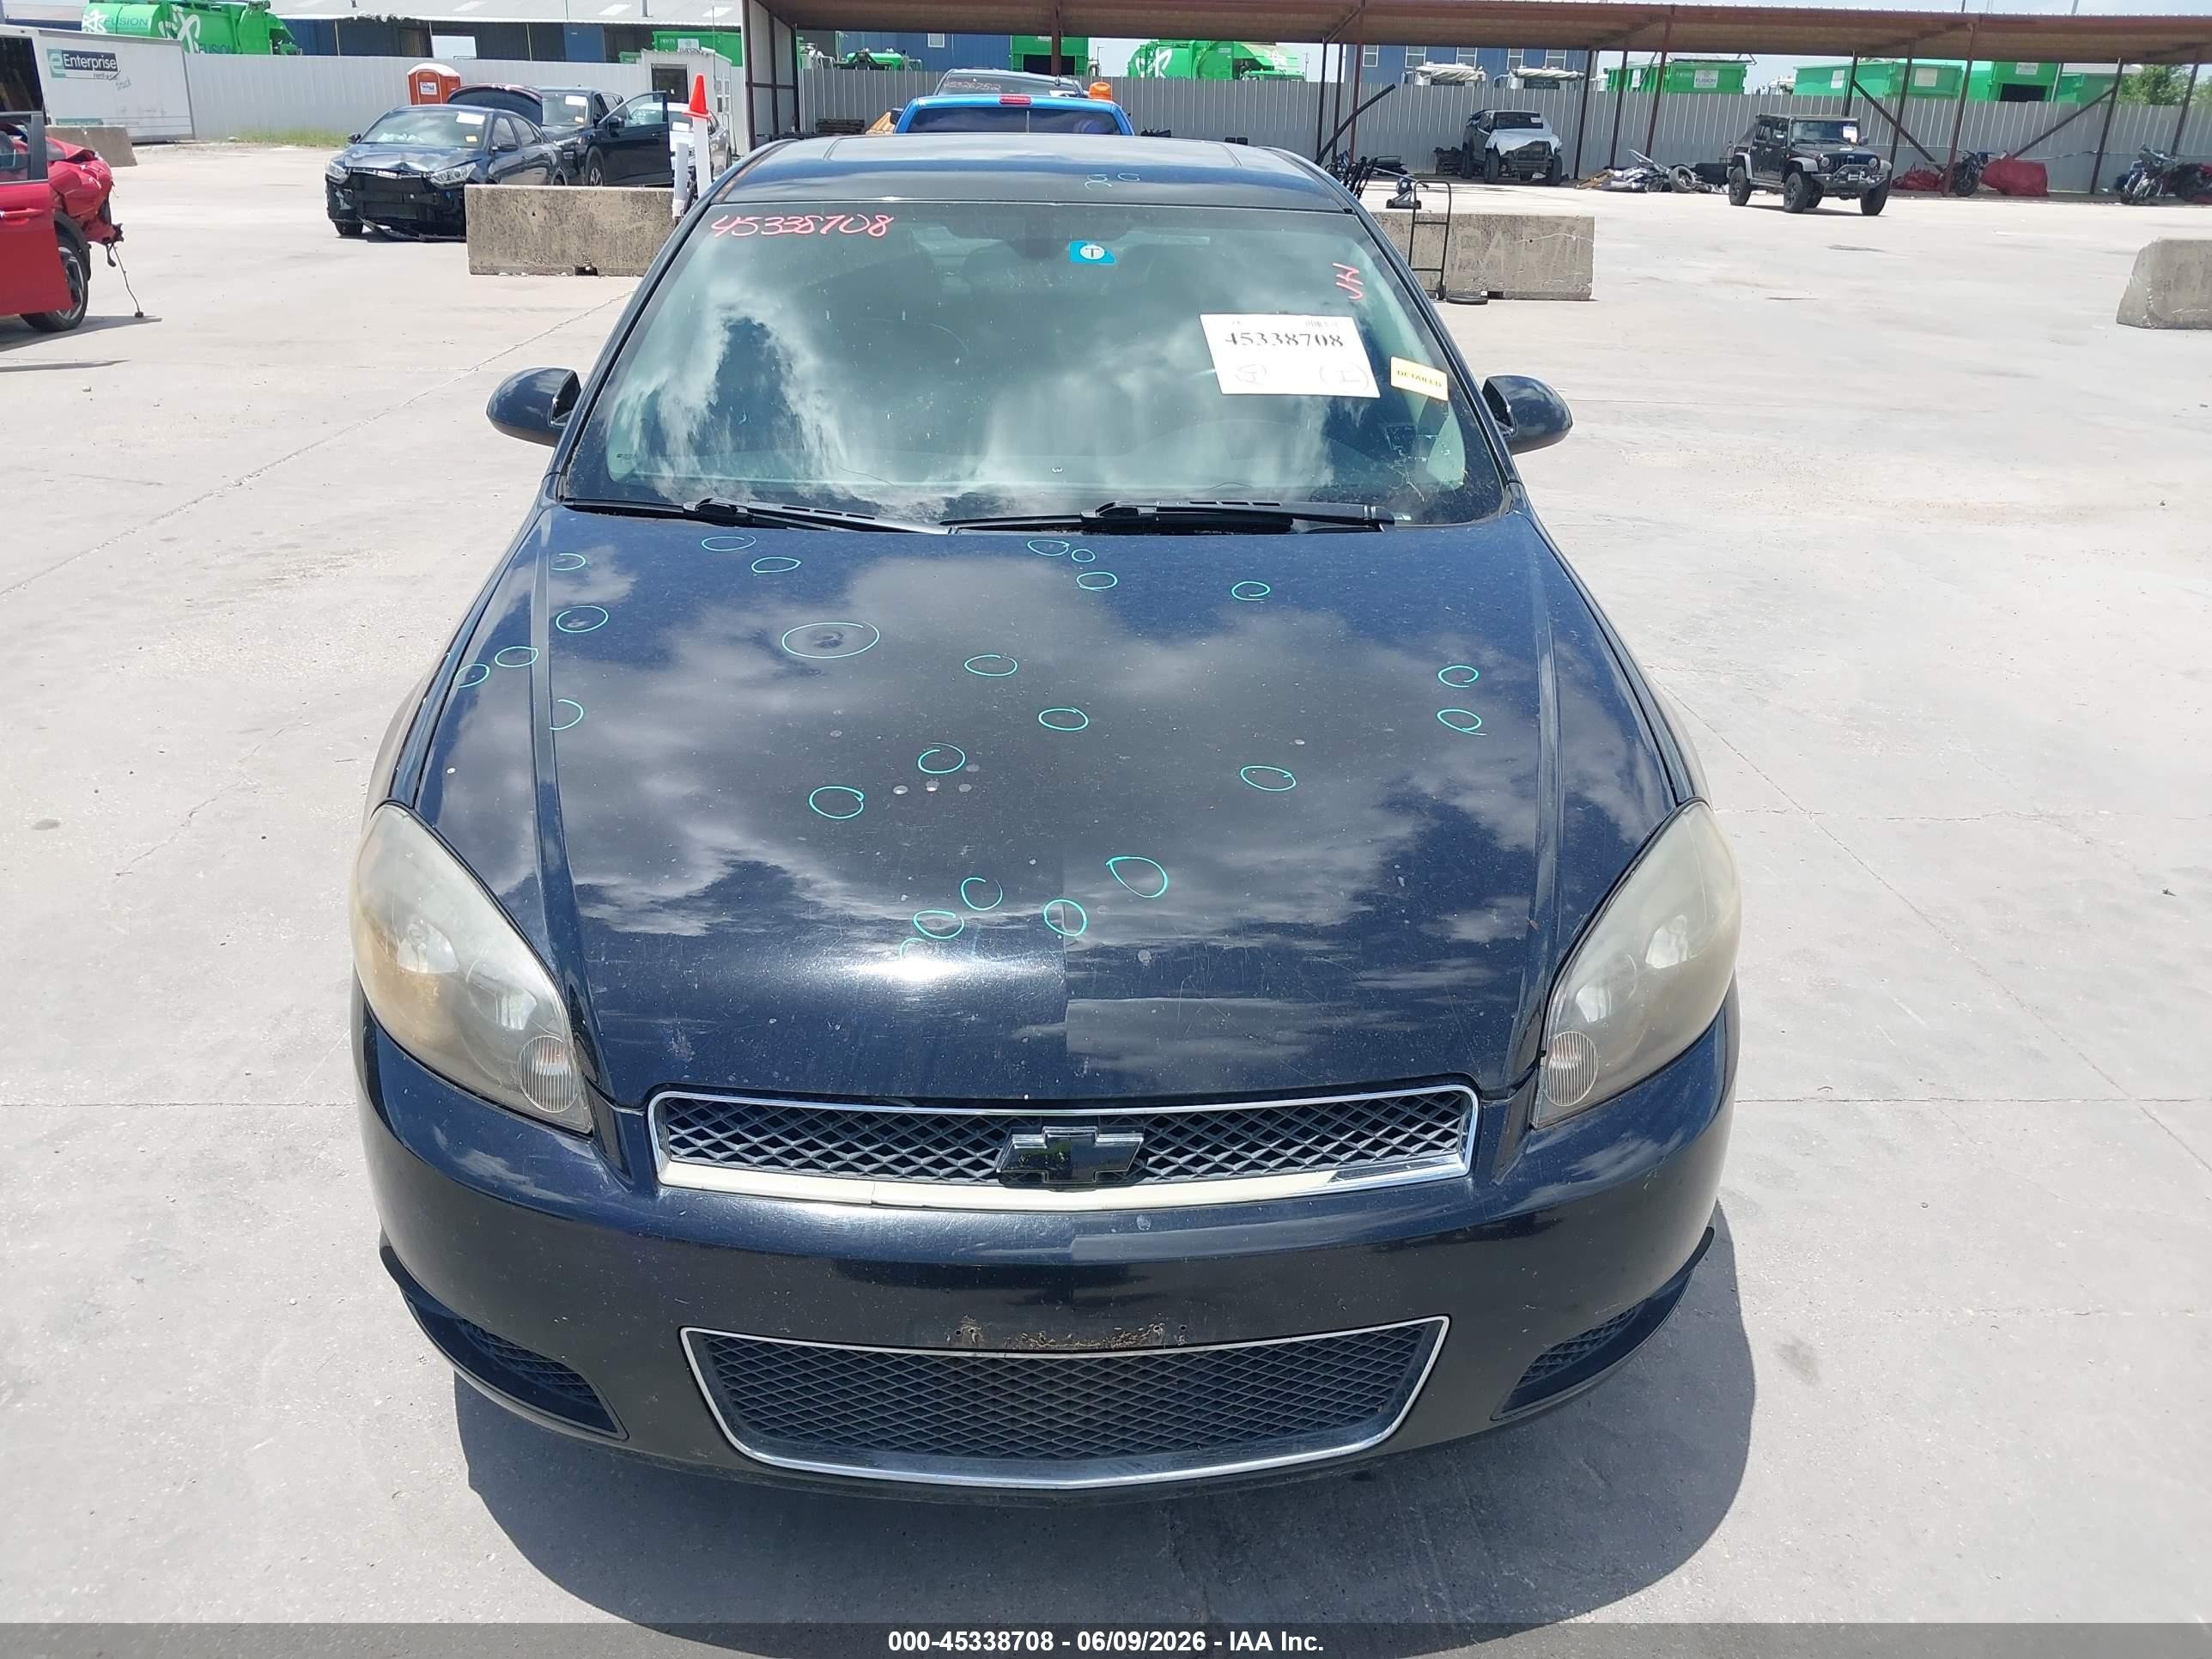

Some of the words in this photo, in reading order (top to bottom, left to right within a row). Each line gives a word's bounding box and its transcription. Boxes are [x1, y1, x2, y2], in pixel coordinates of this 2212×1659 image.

[104, 18, 149, 27] FUSION
[64, 53, 117, 70] Enterprise
[711, 215, 895, 237] 45338708
[1225, 331, 1344, 347] 45338708
